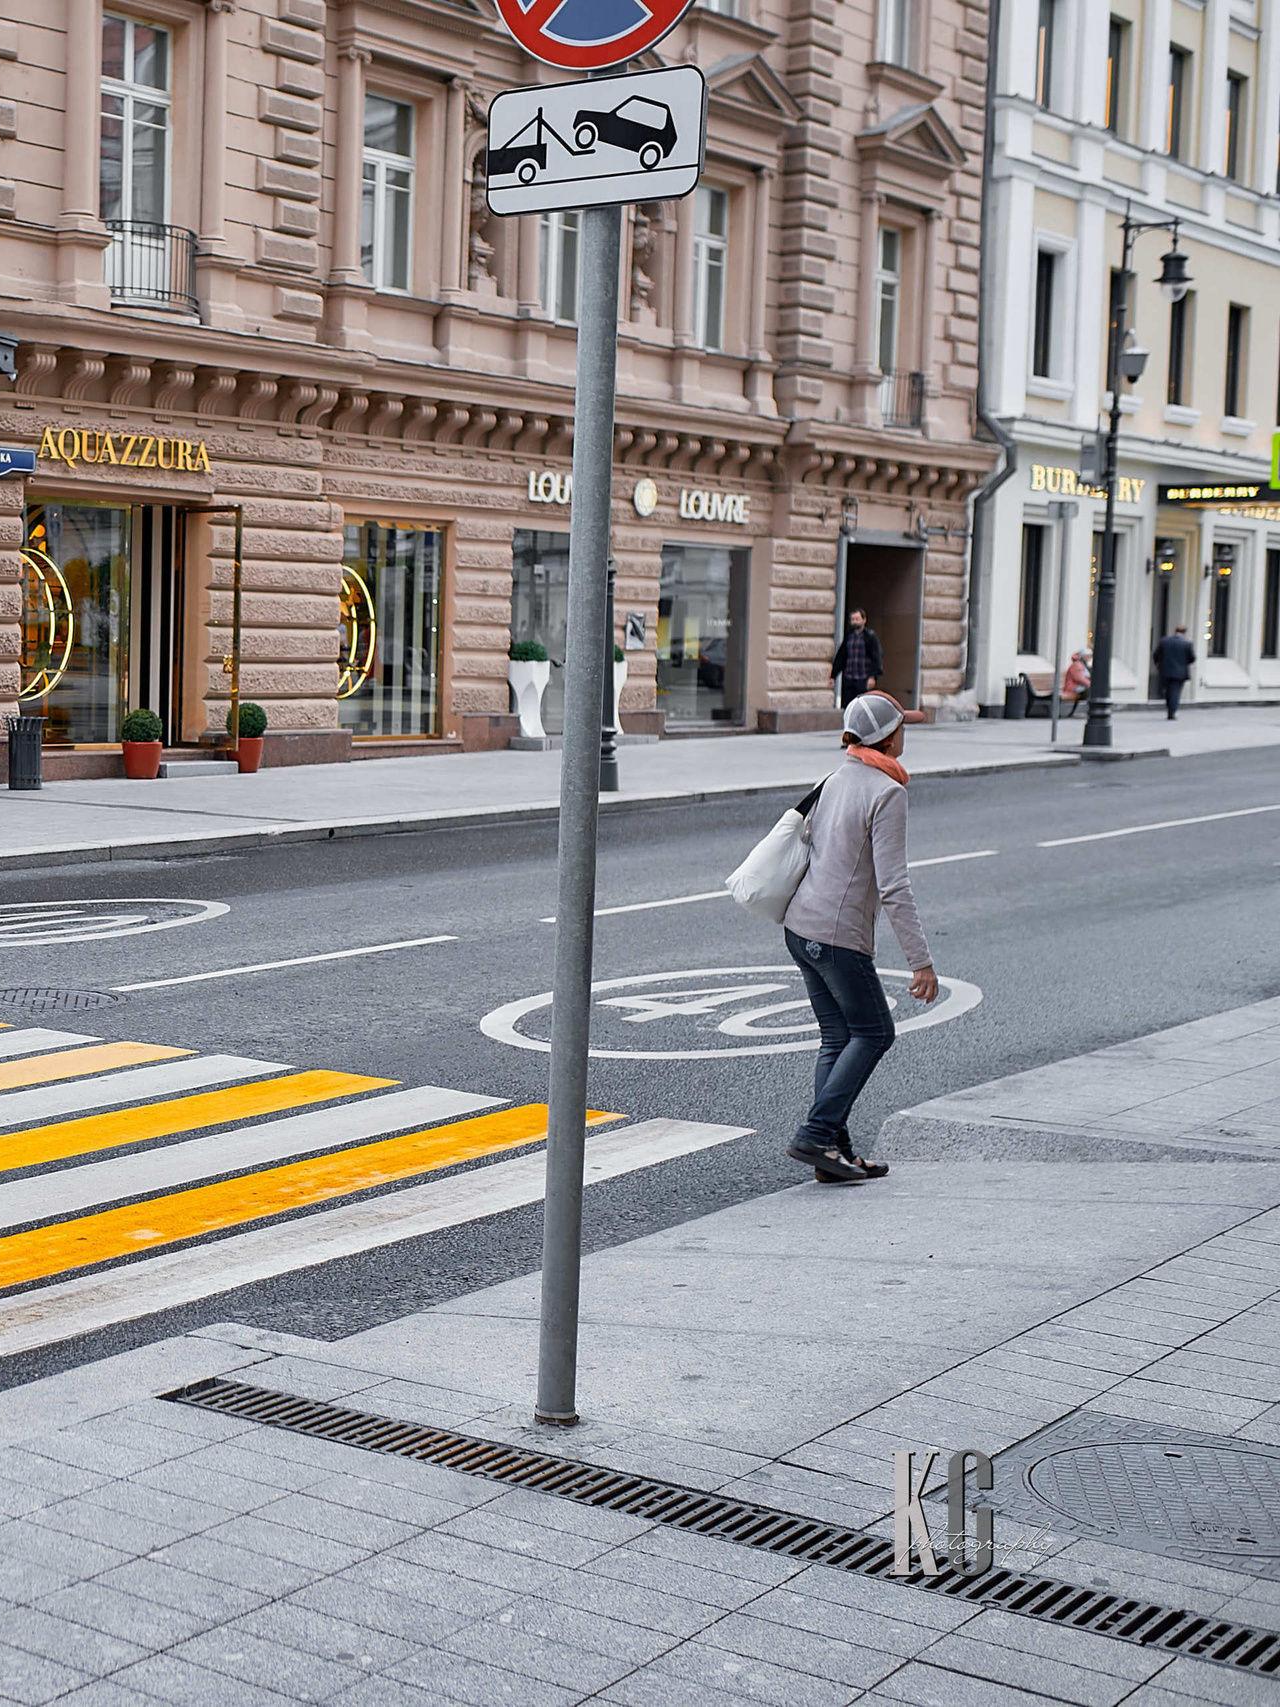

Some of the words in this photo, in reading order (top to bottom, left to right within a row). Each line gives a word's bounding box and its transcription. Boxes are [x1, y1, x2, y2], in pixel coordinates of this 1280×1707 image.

[37, 426, 213, 473] AQUAZZURA
[528, 470, 573, 505] LOU
[1031, 464, 1145, 503] BURRY
[1167, 486, 1260, 500] BURBERRY
[680, 489, 751, 524] LOUVRE
